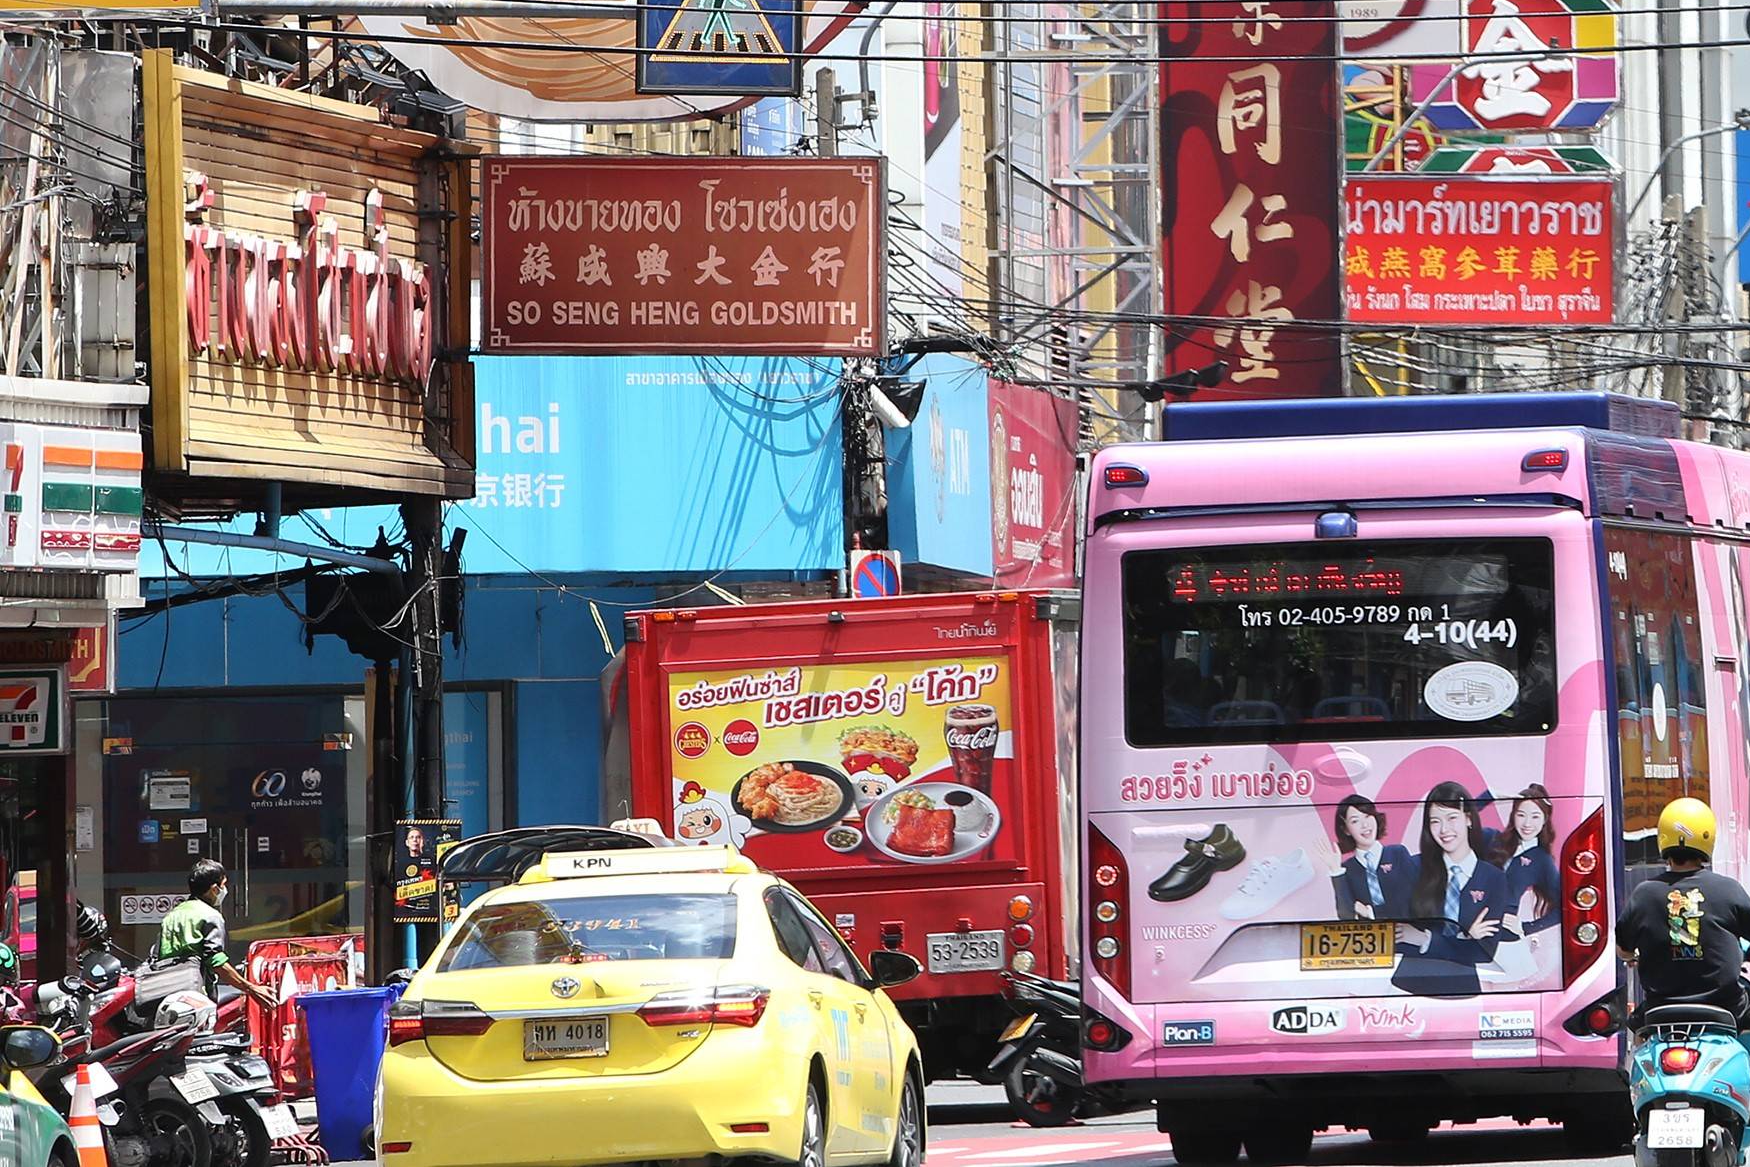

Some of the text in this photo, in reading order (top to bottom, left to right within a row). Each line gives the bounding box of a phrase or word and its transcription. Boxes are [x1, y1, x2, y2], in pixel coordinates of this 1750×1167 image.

[1350, 8, 1378, 19] 1989
[507, 178, 857, 233] ห้างขายทอง โซวเซ่งเฮง
[517, 241, 848, 287] 蘇成興大金行
[507, 300, 857, 326] SO SENG HENG GOLDSMITH
[1238, 604, 1450, 629] โทร 02-405-9789 กด 1
[1403, 618, 1518, 649] 4-10(44)
[677, 668, 798, 708] อร่อยฟินซ่าส์
[765, 675, 885, 724] เชสเตอร์
[888, 685, 905, 715] คู่
[573, 857, 612, 869] KPN
[932, 940, 999, 962] 53-2539
[1309, 933, 1386, 955] 16-7531
[565, 1023, 603, 1040] 4018
[1276, 1011, 1339, 1031] ADDA
[1503, 1016, 1533, 1026] MEDIA
